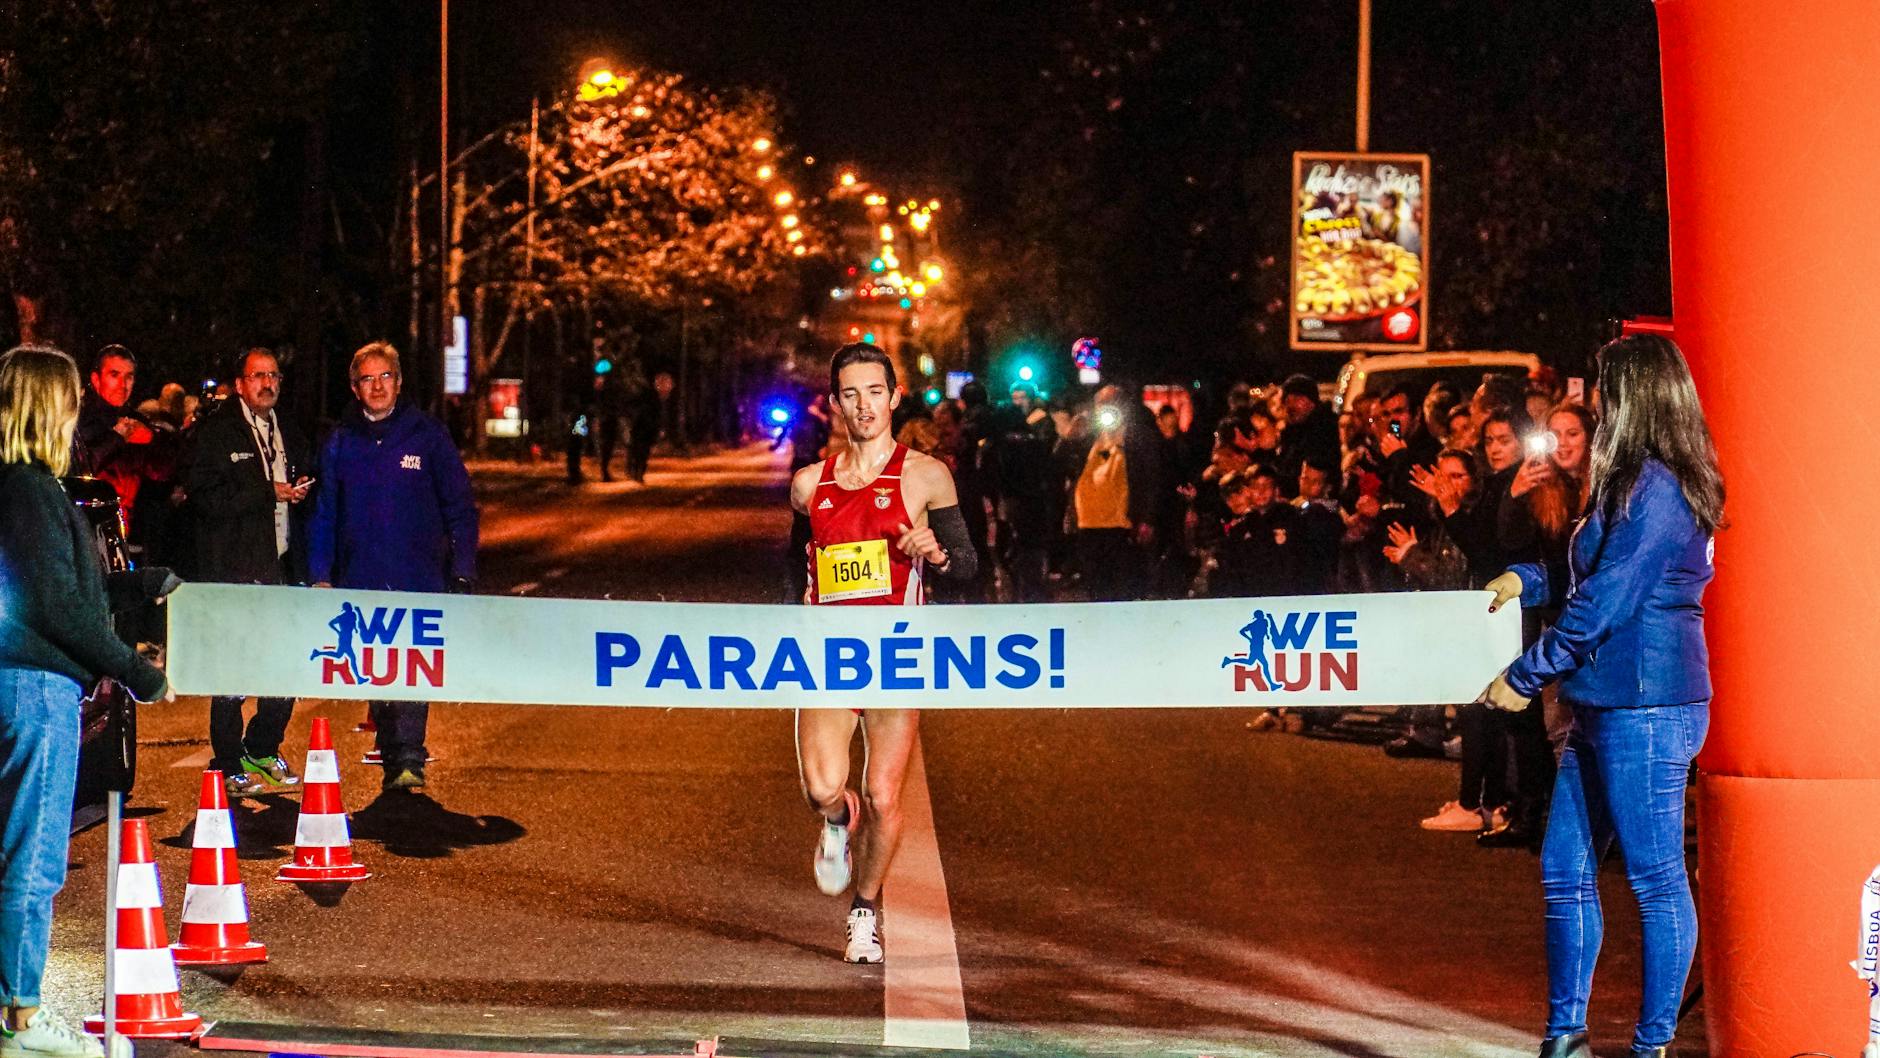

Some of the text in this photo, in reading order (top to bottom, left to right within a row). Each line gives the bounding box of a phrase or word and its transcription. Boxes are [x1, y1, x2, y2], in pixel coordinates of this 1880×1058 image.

[832, 559, 872, 583] 1504
[354, 606, 444, 646] WE
[1266, 611, 1357, 649] WE
[322, 646, 444, 687] RUN
[595, 621, 1065, 690] PARABÉNS!
[1234, 652, 1358, 692] RUN
[1863, 911, 1880, 973] LISBOA
